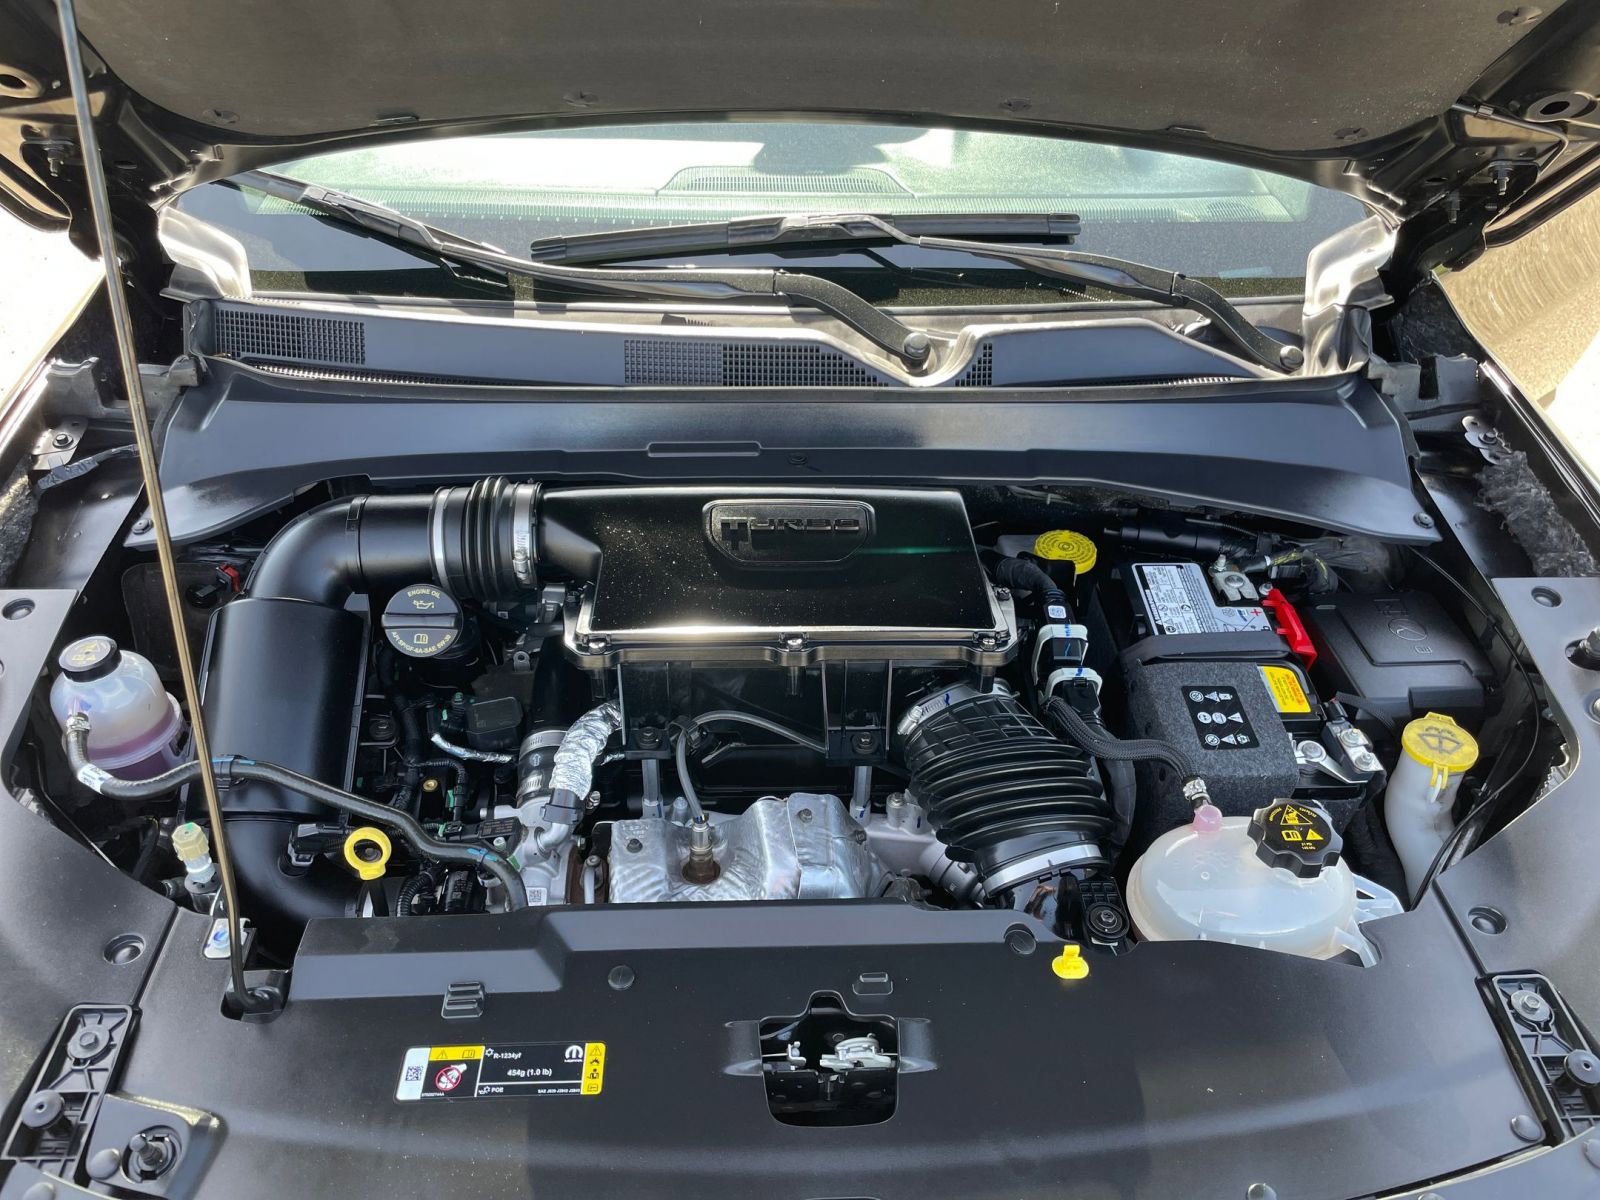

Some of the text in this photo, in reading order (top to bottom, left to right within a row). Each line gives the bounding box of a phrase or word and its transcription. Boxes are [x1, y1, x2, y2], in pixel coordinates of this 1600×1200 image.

[720, 517, 860, 531] TURBO
[407, 588, 441, 599] ENGINE OIL
[493, 1052, 522, 1060] R-1234yf
[507, 1068, 553, 1077] 454g (1.0 lb)
